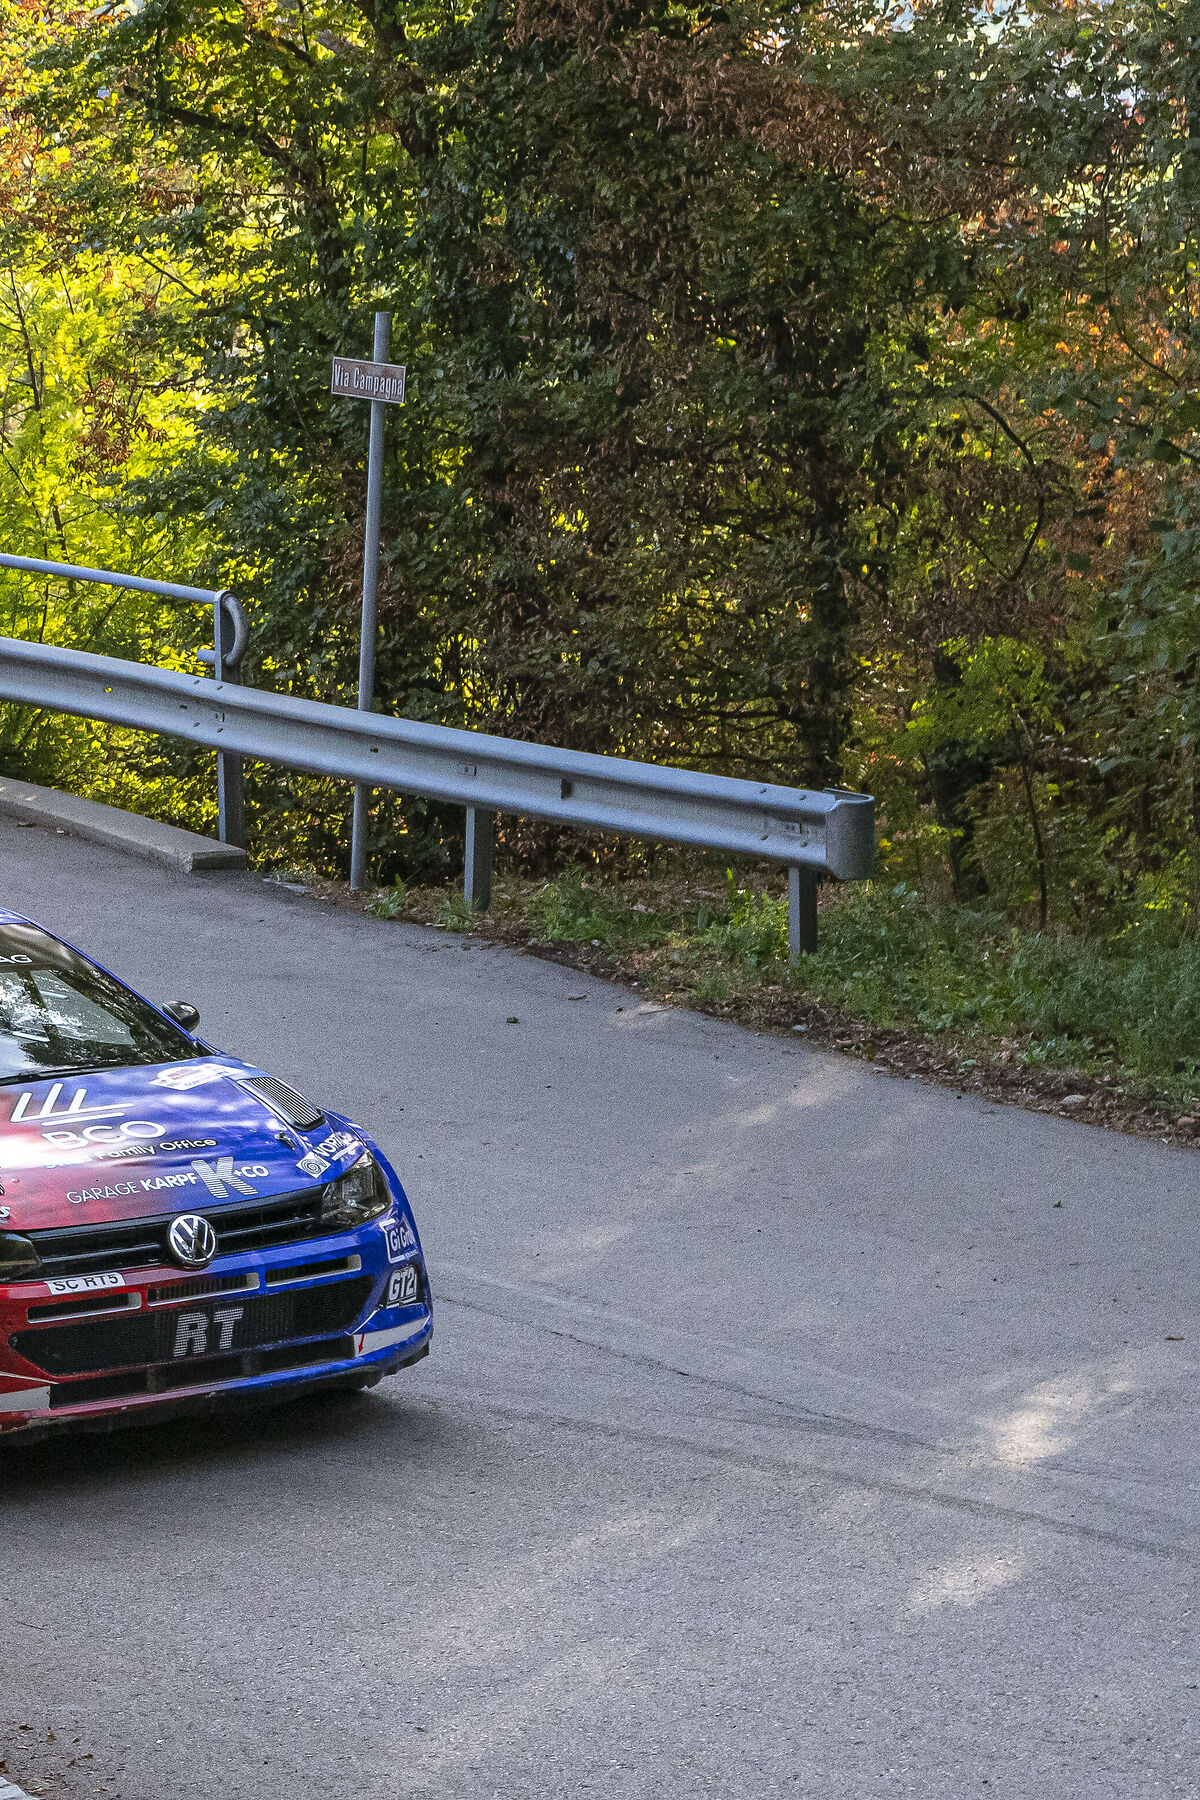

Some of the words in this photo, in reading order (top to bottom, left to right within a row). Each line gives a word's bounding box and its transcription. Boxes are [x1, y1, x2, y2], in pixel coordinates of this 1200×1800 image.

[334, 364, 349, 387] Via
[353, 367, 403, 399] Campagna
[41, 1120, 167, 1150] BCO
[159, 1138, 218, 1152] Office
[66, 1182, 140, 1204] GARAGE
[140, 1172, 199, 1191] KARPF
[54, 1278, 79, 1292] SC
[84, 1273, 119, 1288] RT5
[173, 1307, 244, 1357] RT
